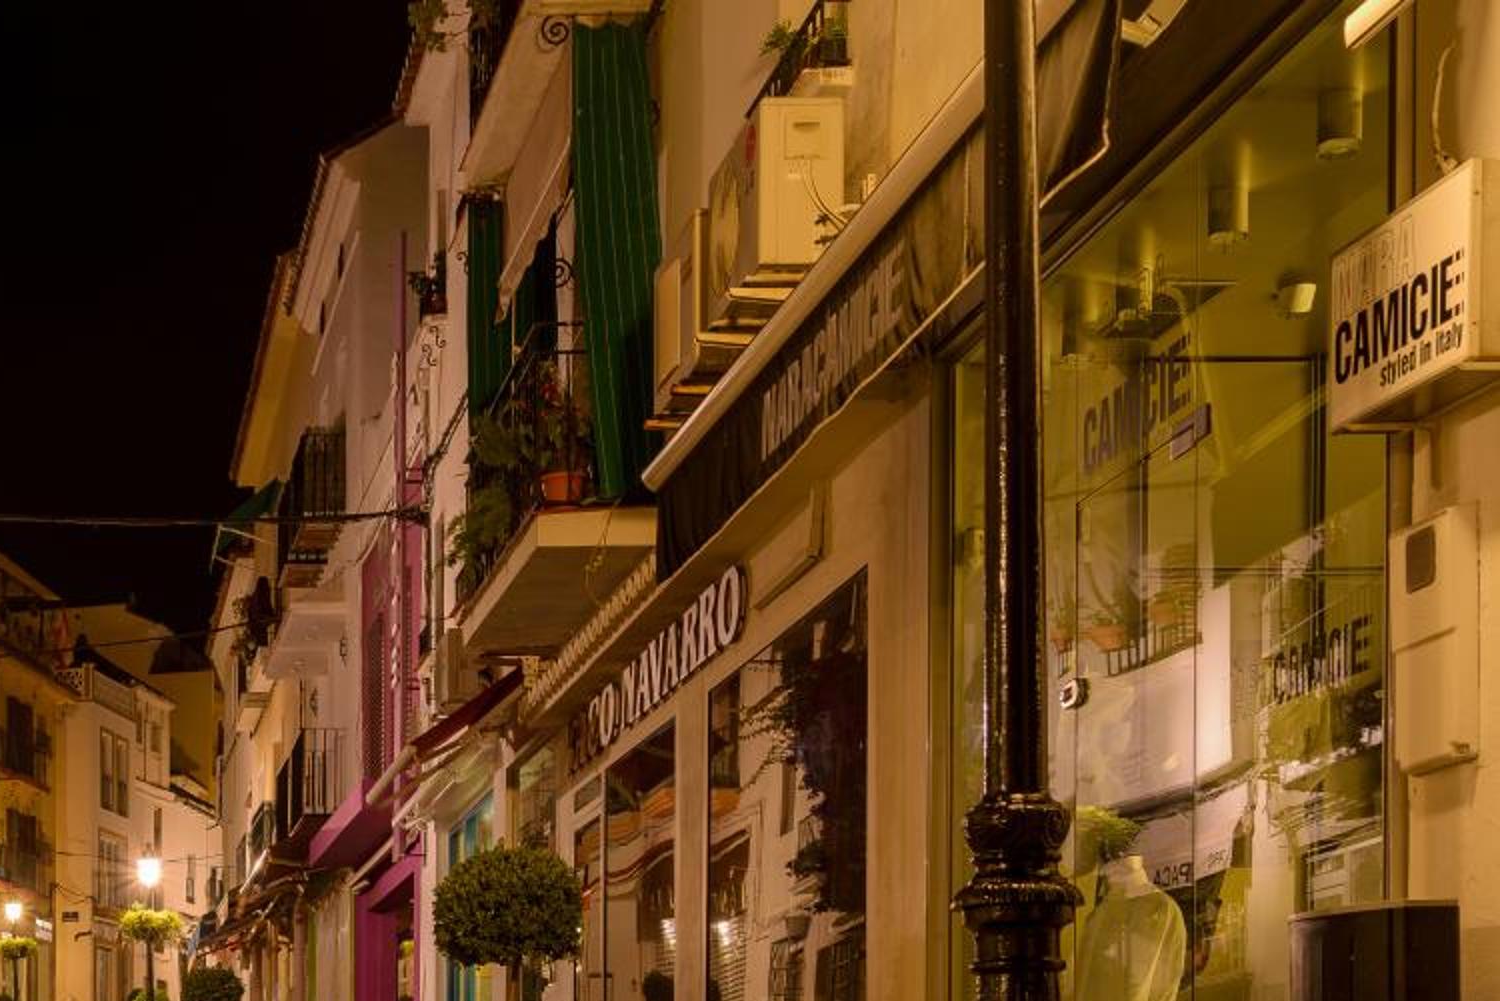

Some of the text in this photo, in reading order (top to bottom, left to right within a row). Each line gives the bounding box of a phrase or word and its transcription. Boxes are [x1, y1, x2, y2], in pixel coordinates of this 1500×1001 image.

[1335, 250, 1464, 385] CAMICIE
[1380, 343, 1417, 388] styled
[1420, 339, 1432, 365] in
[621, 565, 741, 730] NAVARRO
